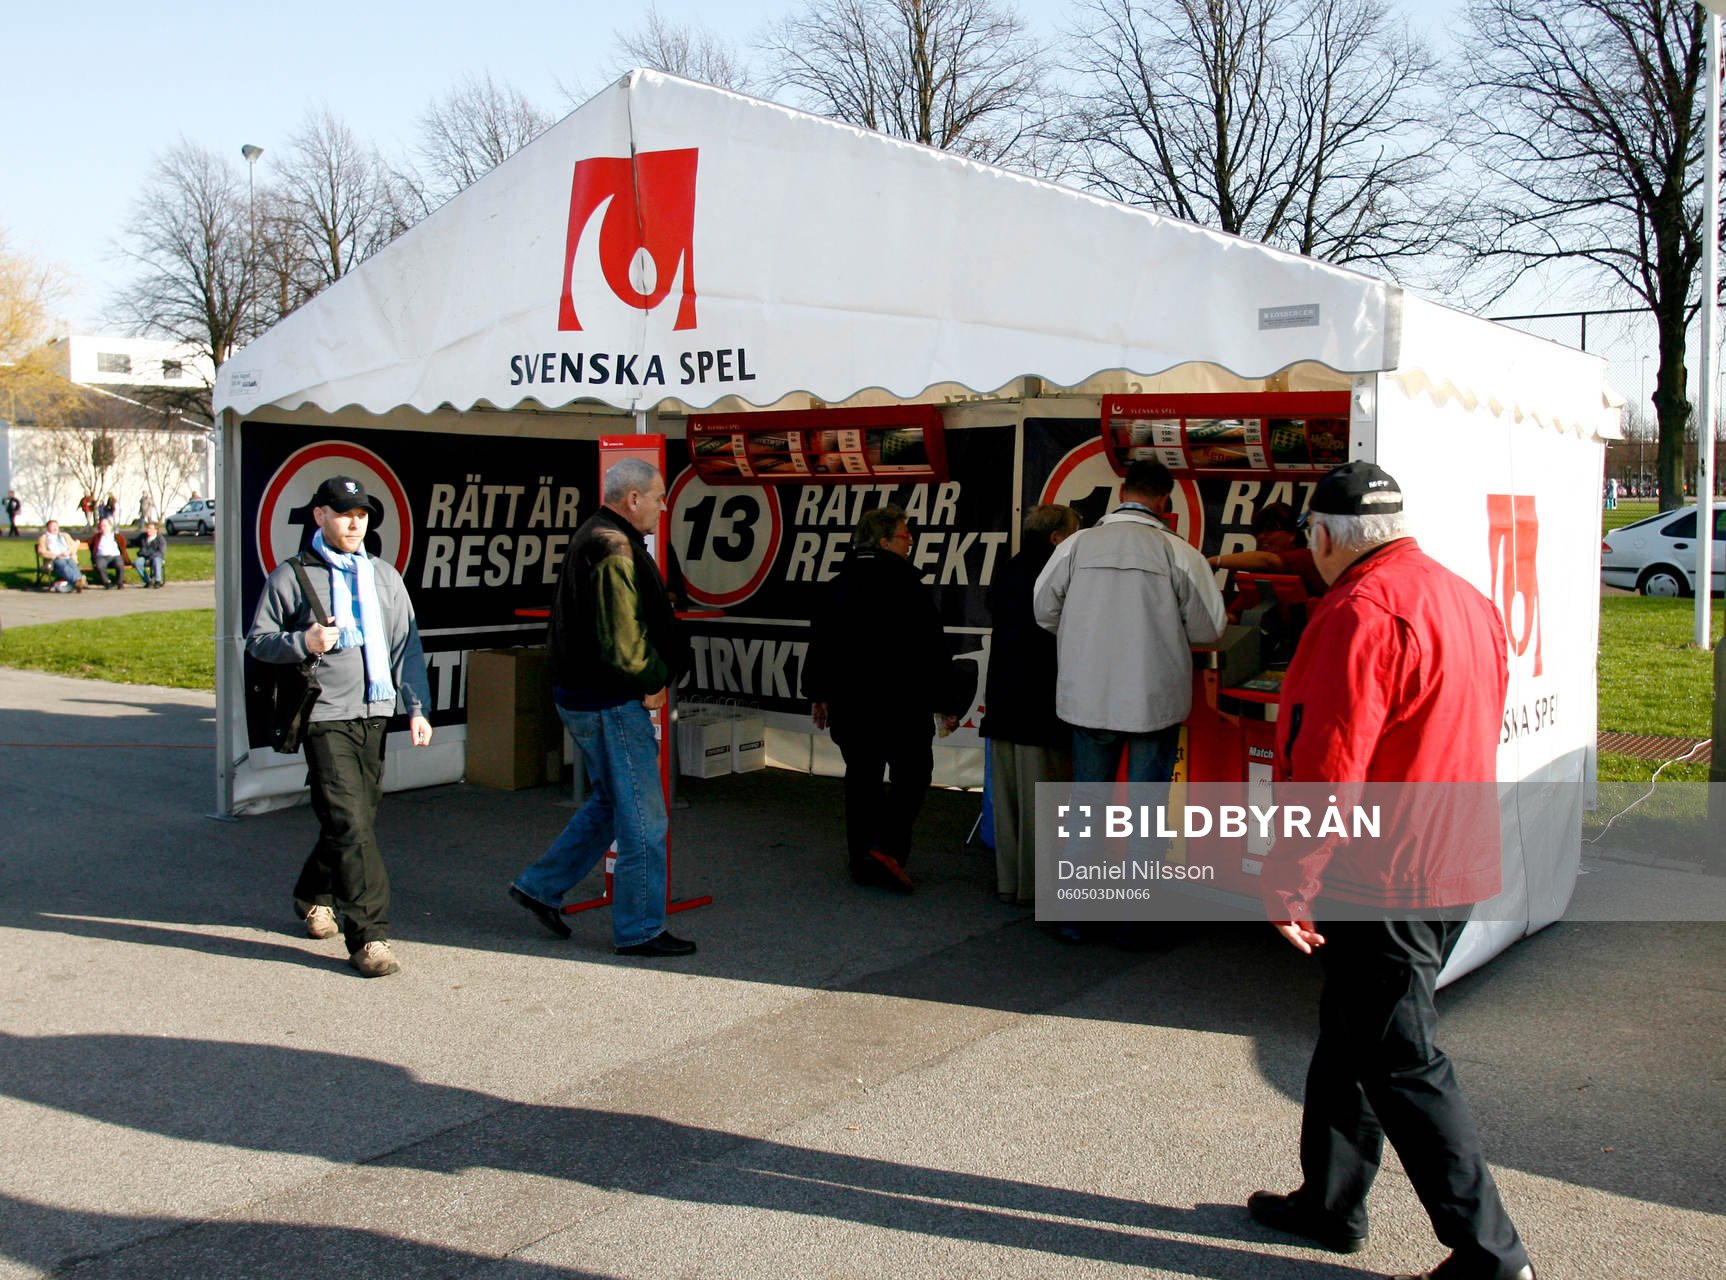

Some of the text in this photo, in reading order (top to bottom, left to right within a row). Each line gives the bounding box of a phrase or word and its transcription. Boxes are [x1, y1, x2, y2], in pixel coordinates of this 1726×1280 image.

[510, 348, 756, 386] SVENSKA SPEL
[426, 474, 580, 529] RÄTT ÄR
[683, 495, 760, 562] 13
[421, 534, 570, 589] RESPE
[785, 531, 1009, 586] REEKT
[1249, 746, 1274, 759] Match
